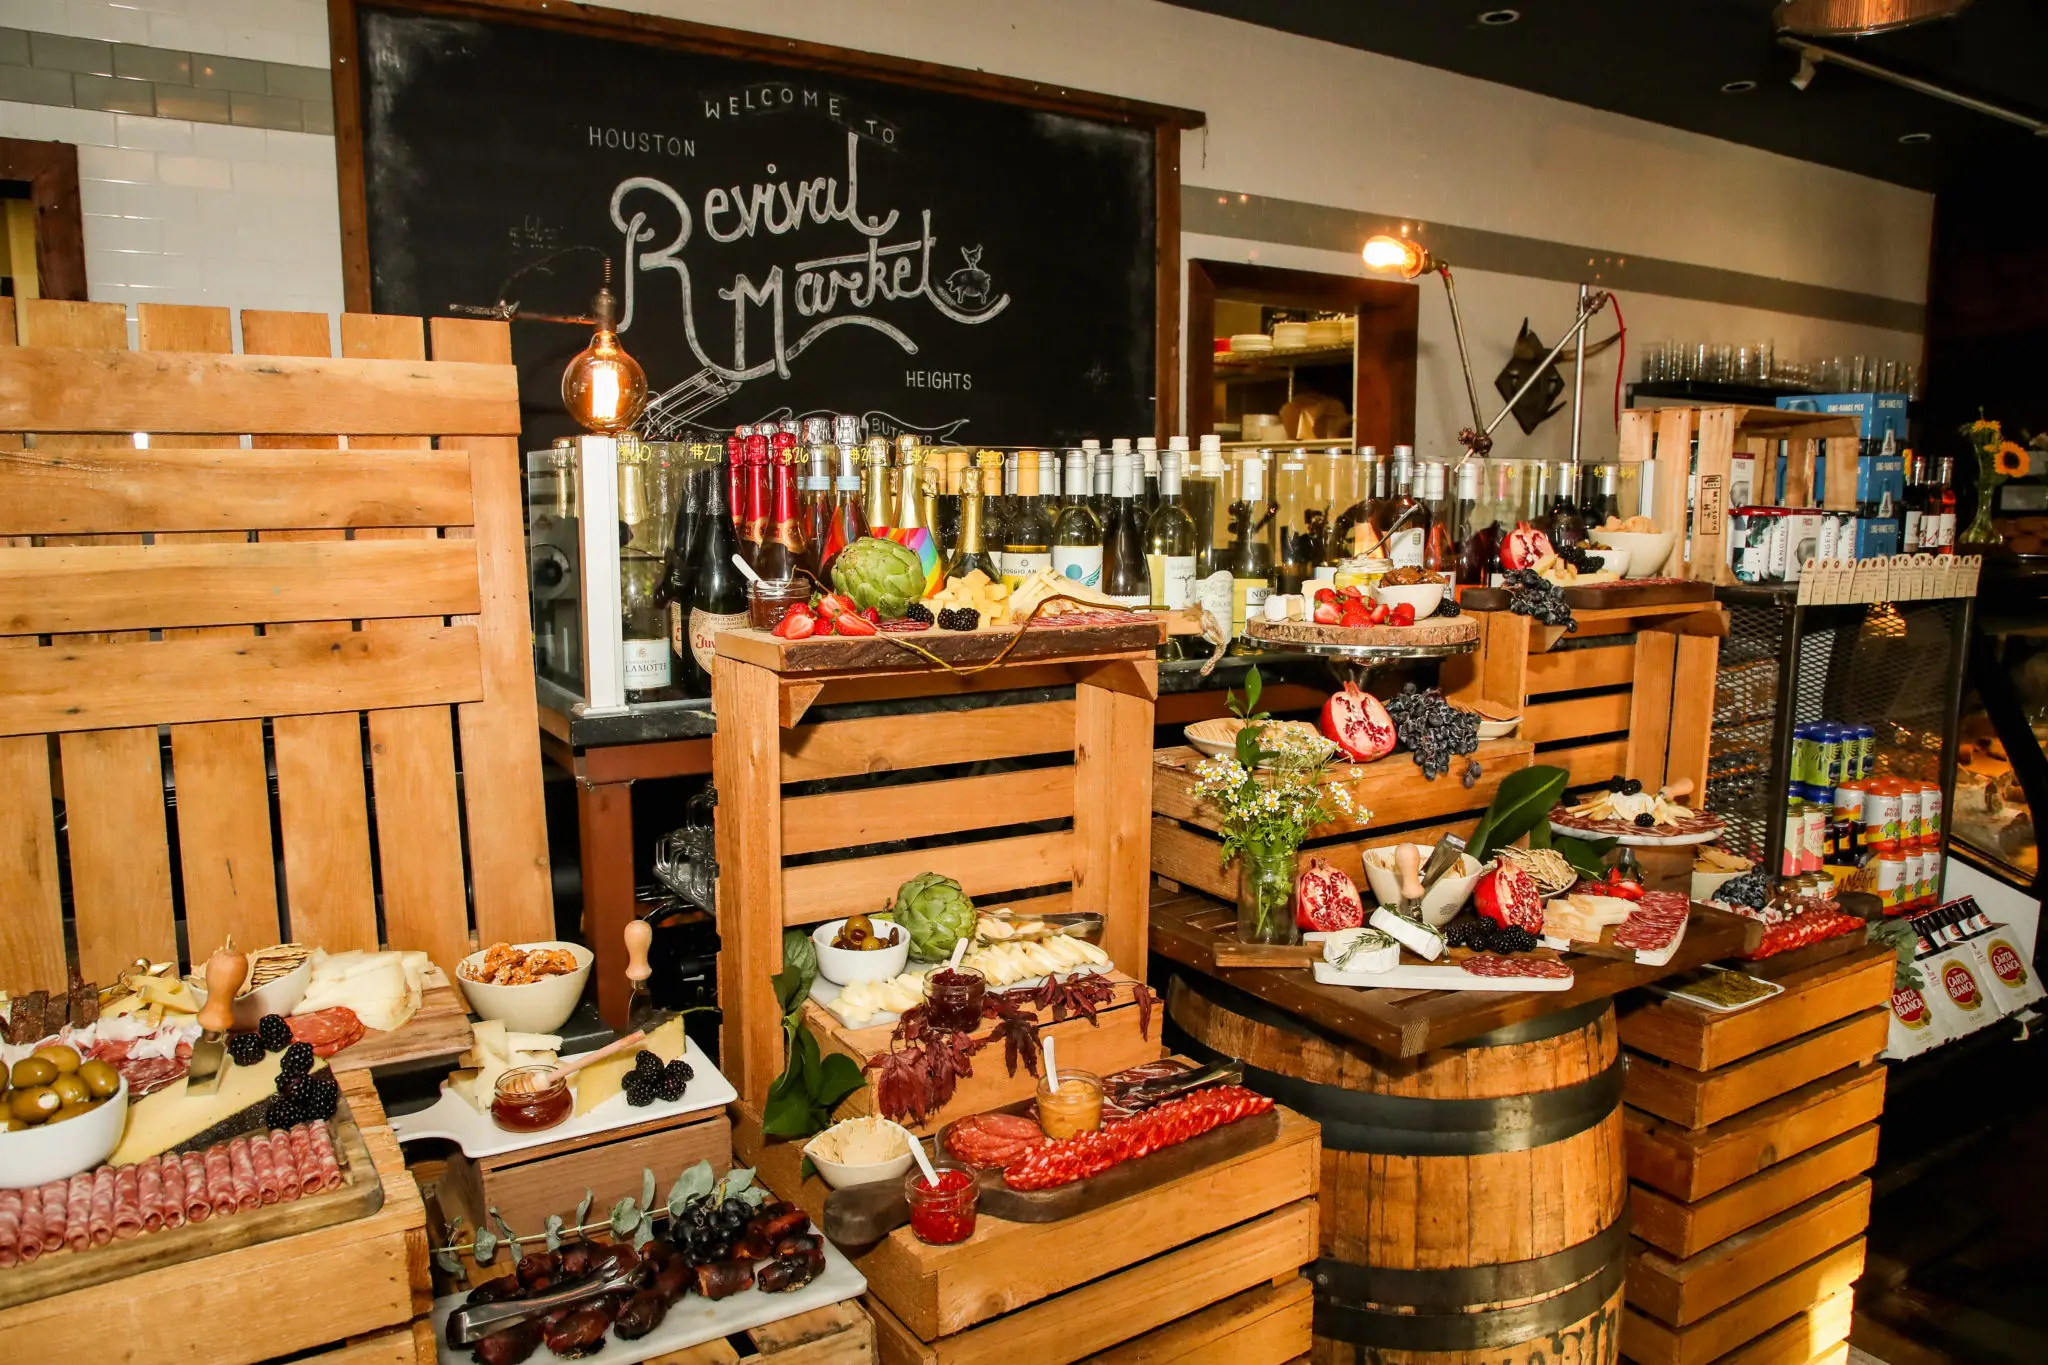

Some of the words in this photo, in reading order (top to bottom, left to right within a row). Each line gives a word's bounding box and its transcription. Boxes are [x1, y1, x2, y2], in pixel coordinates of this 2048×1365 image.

[705, 88, 841, 120] WELCOME
[866, 119, 896, 145] TO
[588, 126, 696, 158] HOUSTON
[609, 132, 900, 365] Revival
[718, 208, 1011, 379] Market
[905, 369, 973, 391] HEIGHTS
[689, 443, 723, 462] $27
[782, 447, 810, 465] $26
[1777, 525, 1785, 567] TANGENT
[625, 662, 667, 673] LAMOTTE
[1992, 951, 2014, 966] CARTA
[1995, 959, 2021, 976] BLANCA
[1947, 971, 1969, 988] CARTA
[1892, 989, 1917, 1006] CARTA
[1949, 981, 1975, 998] BLANCA
[1895, 998, 1924, 1017] BLANCA
